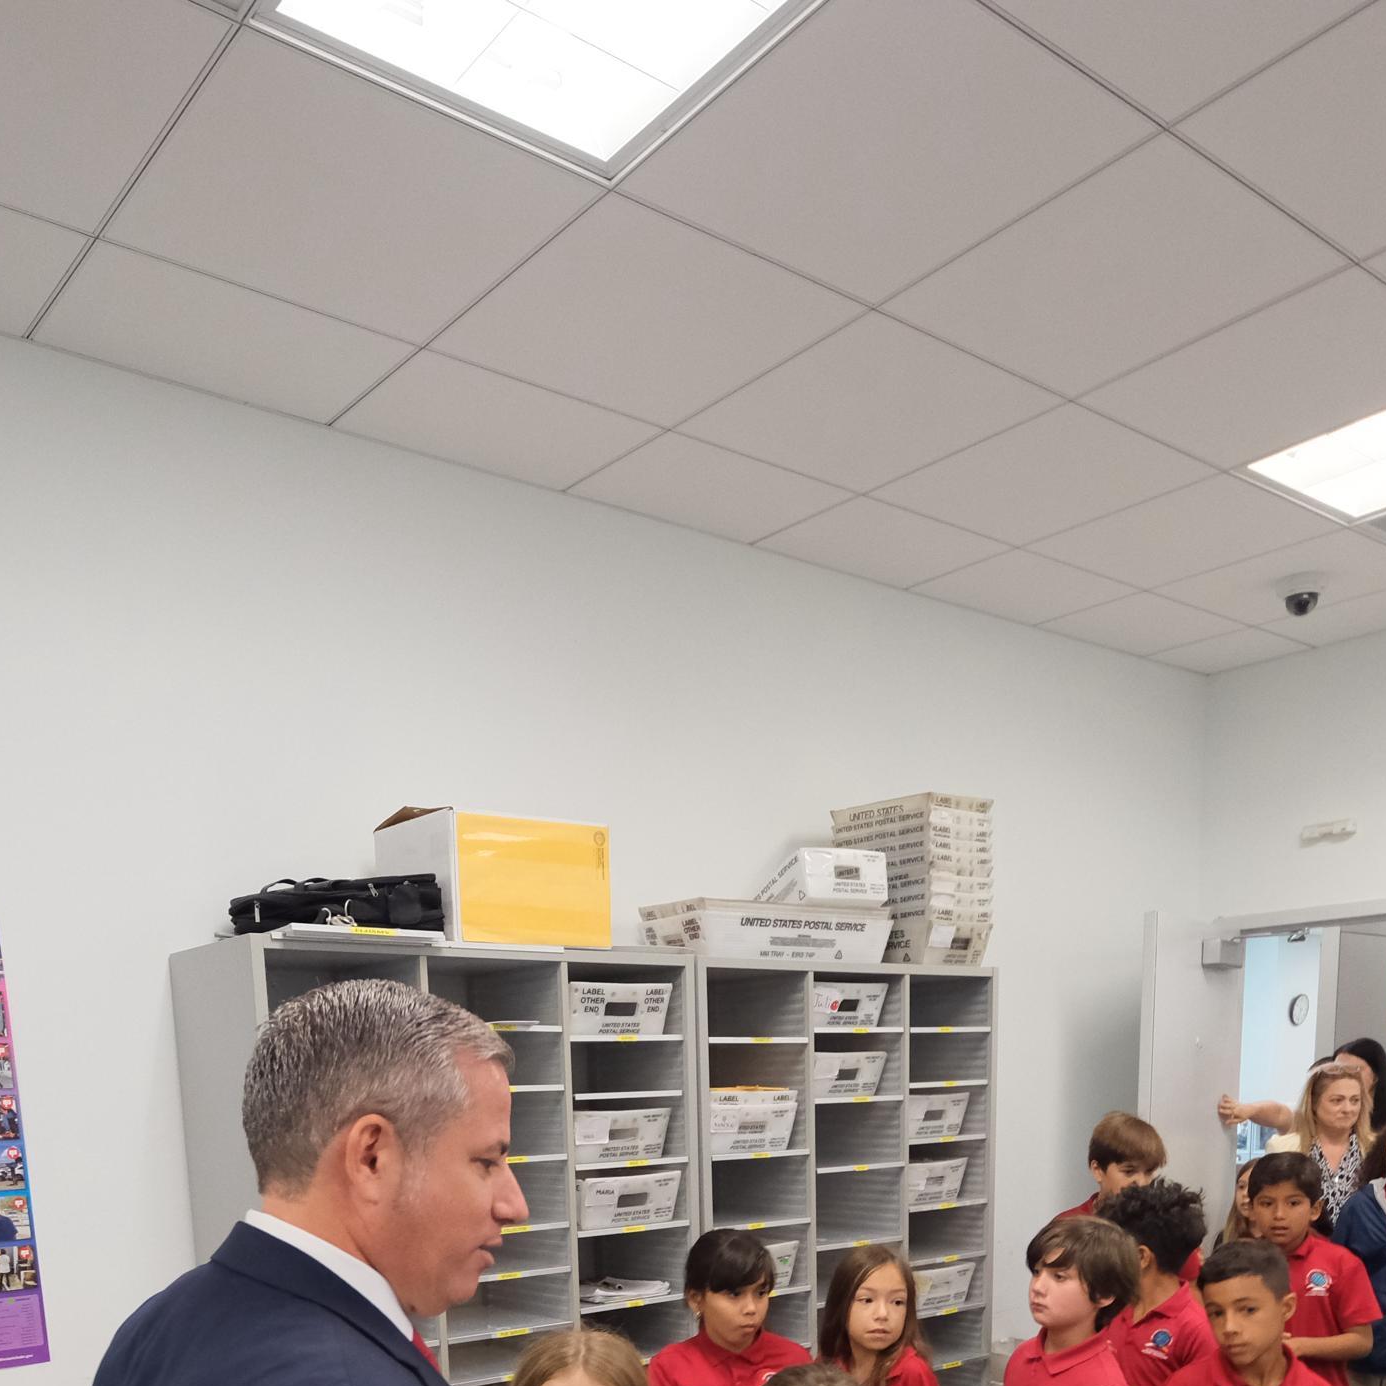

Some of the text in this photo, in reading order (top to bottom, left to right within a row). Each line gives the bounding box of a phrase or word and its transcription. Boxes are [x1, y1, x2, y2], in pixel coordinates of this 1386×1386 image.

[849, 805, 904, 822] UNITED STATES
[835, 811, 924, 834] UNITED STATES POSTAL SERVICE
[835, 825, 924, 848] UNITED STATES POSTAL SERVICE
[898, 840, 924, 851] SERVICE
[935, 841, 951, 850] LABEL
[898, 856, 925, 865] SERVICE
[937, 854, 953, 862] LABEL
[778, 855, 800, 878] SERVICE
[901, 877, 925, 888] SERVICE
[900, 893, 925, 903] SERVICE
[900, 910, 925, 919] SERVICE
[937, 909, 953, 917] LABEL
[682, 918, 698, 927] LABEL
[740, 917, 867, 932] UNITED STATES POSTAL SERVICE
[683, 925, 701, 934] OTHER
